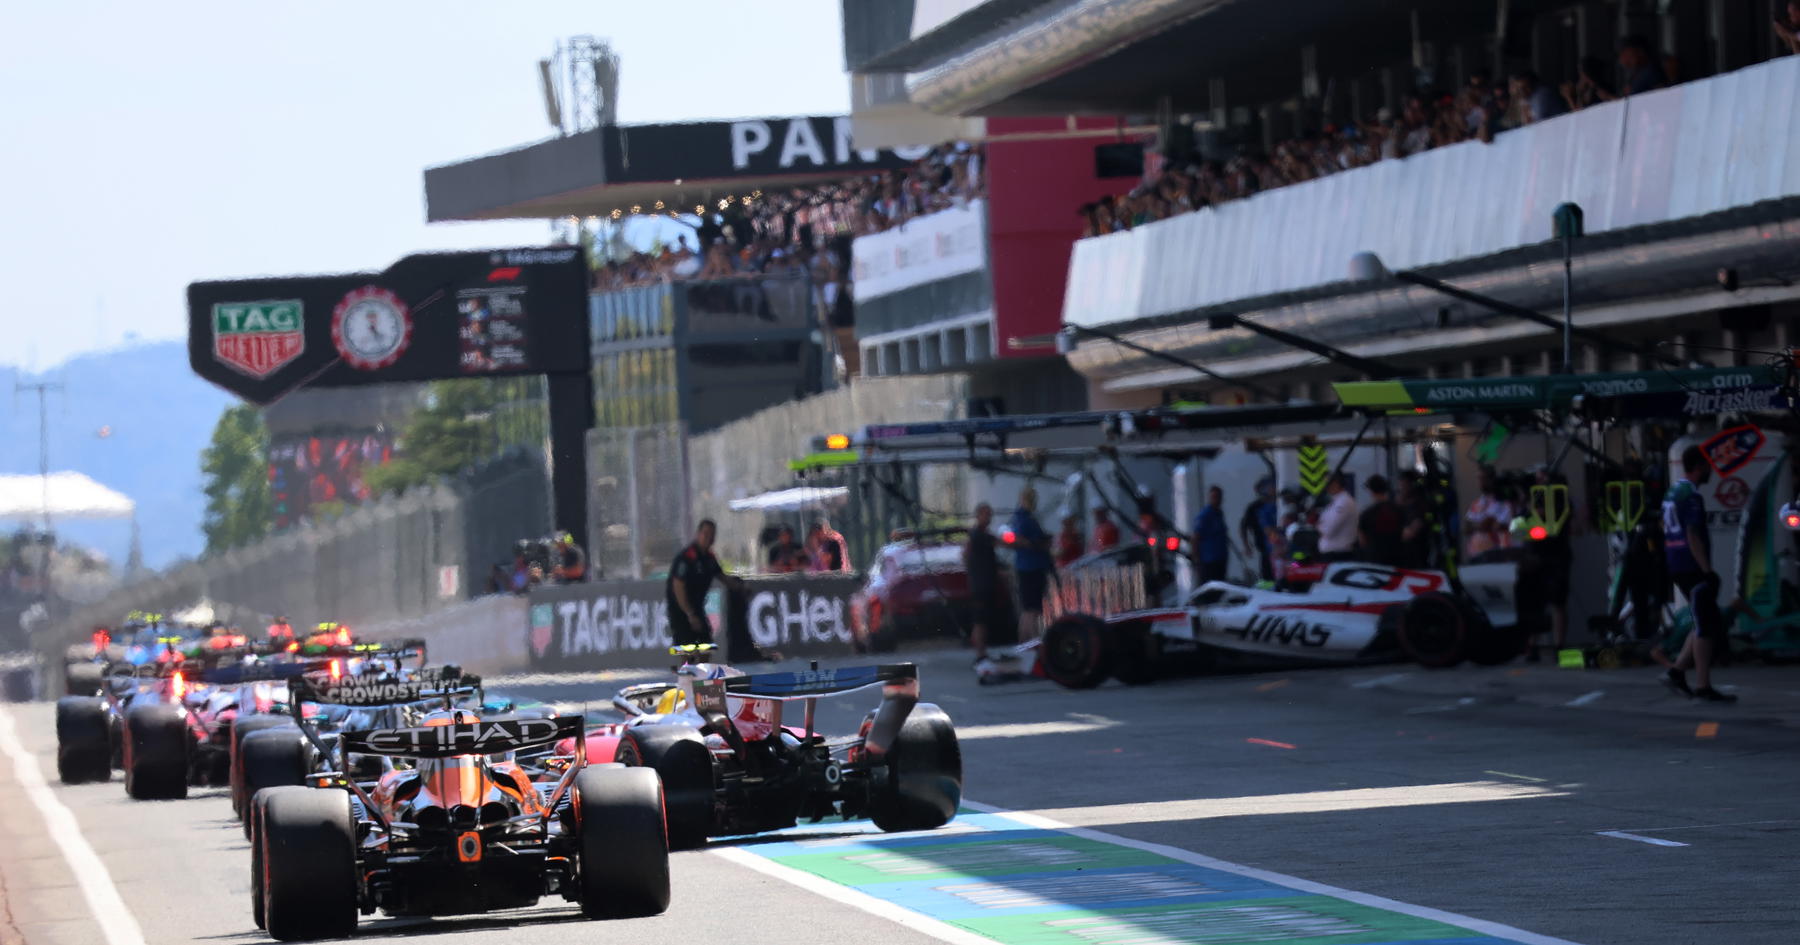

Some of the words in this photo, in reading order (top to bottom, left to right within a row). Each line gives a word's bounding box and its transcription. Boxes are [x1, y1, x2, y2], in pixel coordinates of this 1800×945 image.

[731, 116, 931, 169] PAN
[221, 306, 295, 332] TAG
[1427, 386, 1475, 400] ASTON
[1480, 384, 1534, 398] MARTIN
[1712, 374, 1752, 388] arm
[1225, 614, 1332, 647] HAAS
[794, 670, 838, 690] IBM
[366, 718, 559, 753] ETIHAD
